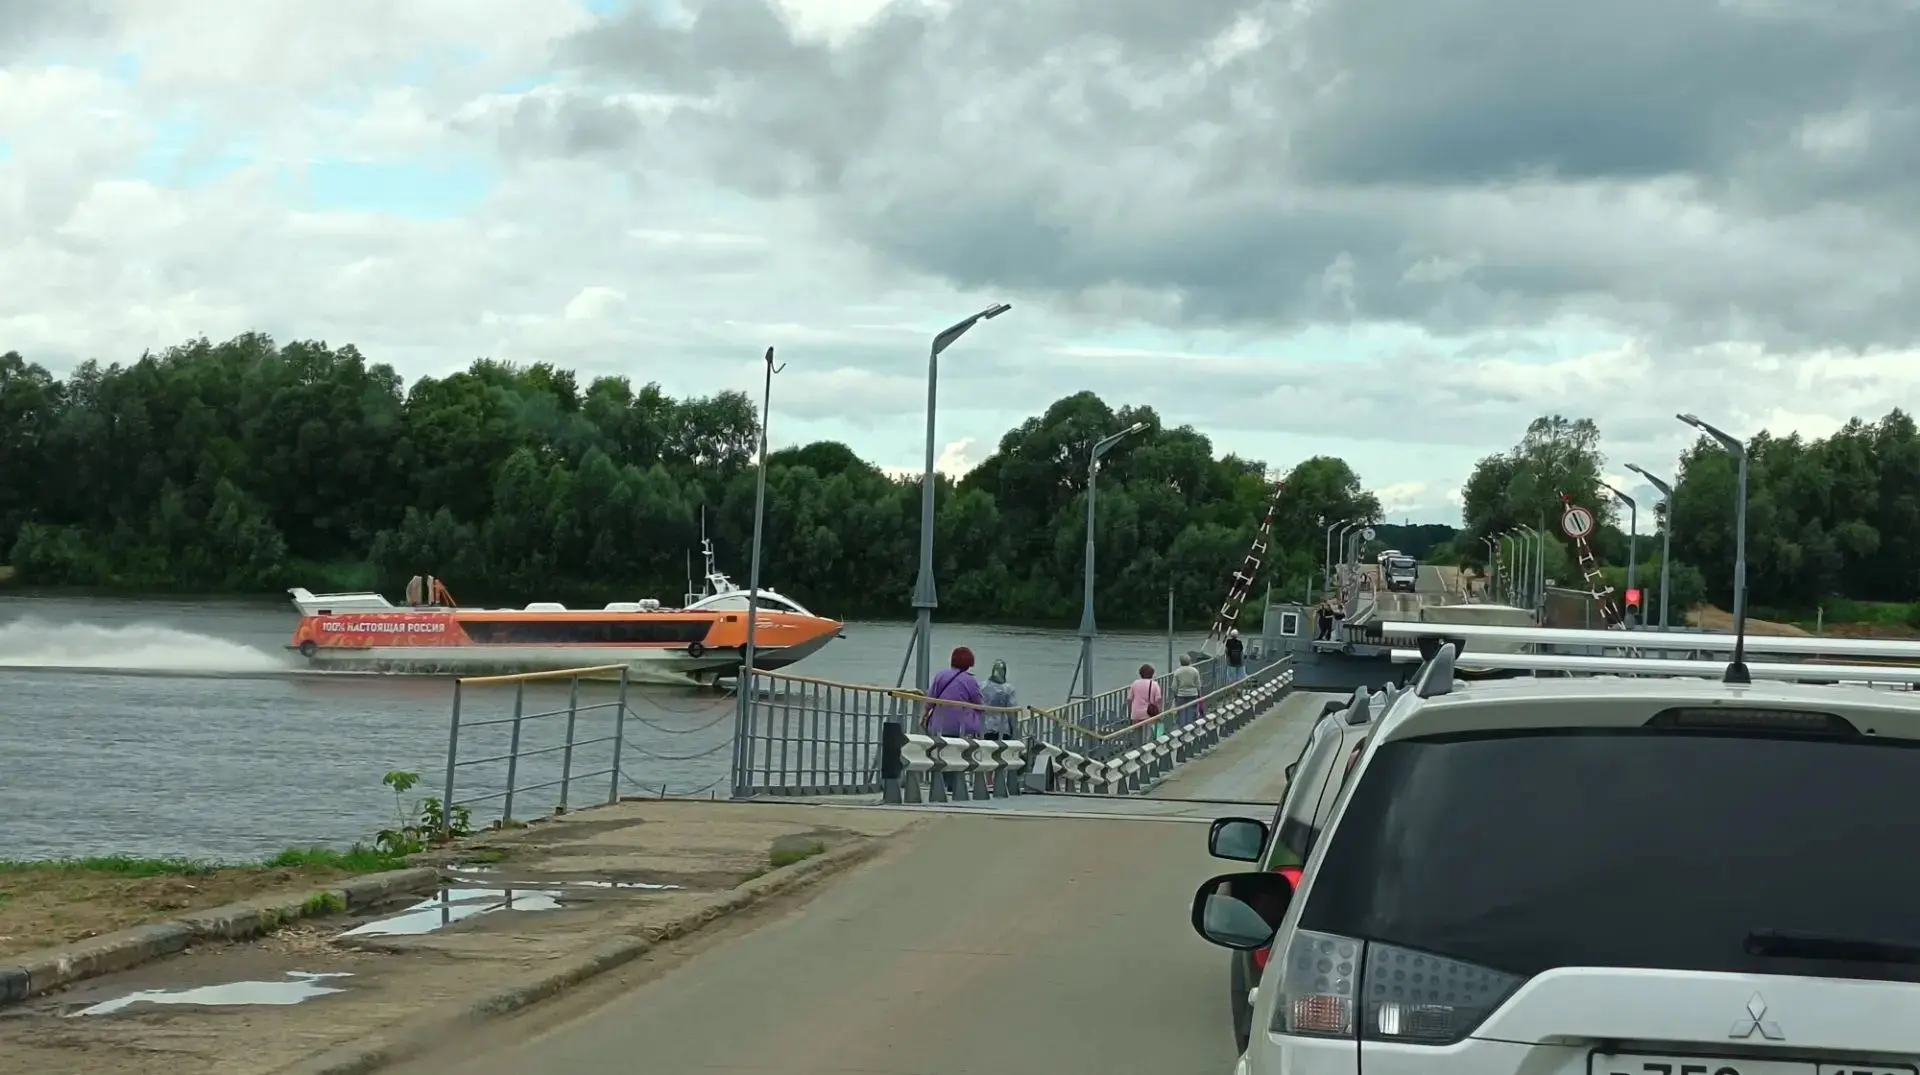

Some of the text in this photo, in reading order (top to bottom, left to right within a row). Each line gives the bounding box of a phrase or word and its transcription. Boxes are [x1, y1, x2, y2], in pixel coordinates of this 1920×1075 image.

[322, 622, 445, 633] 100% НАСТОЯЩАЯ РОССИЯ
